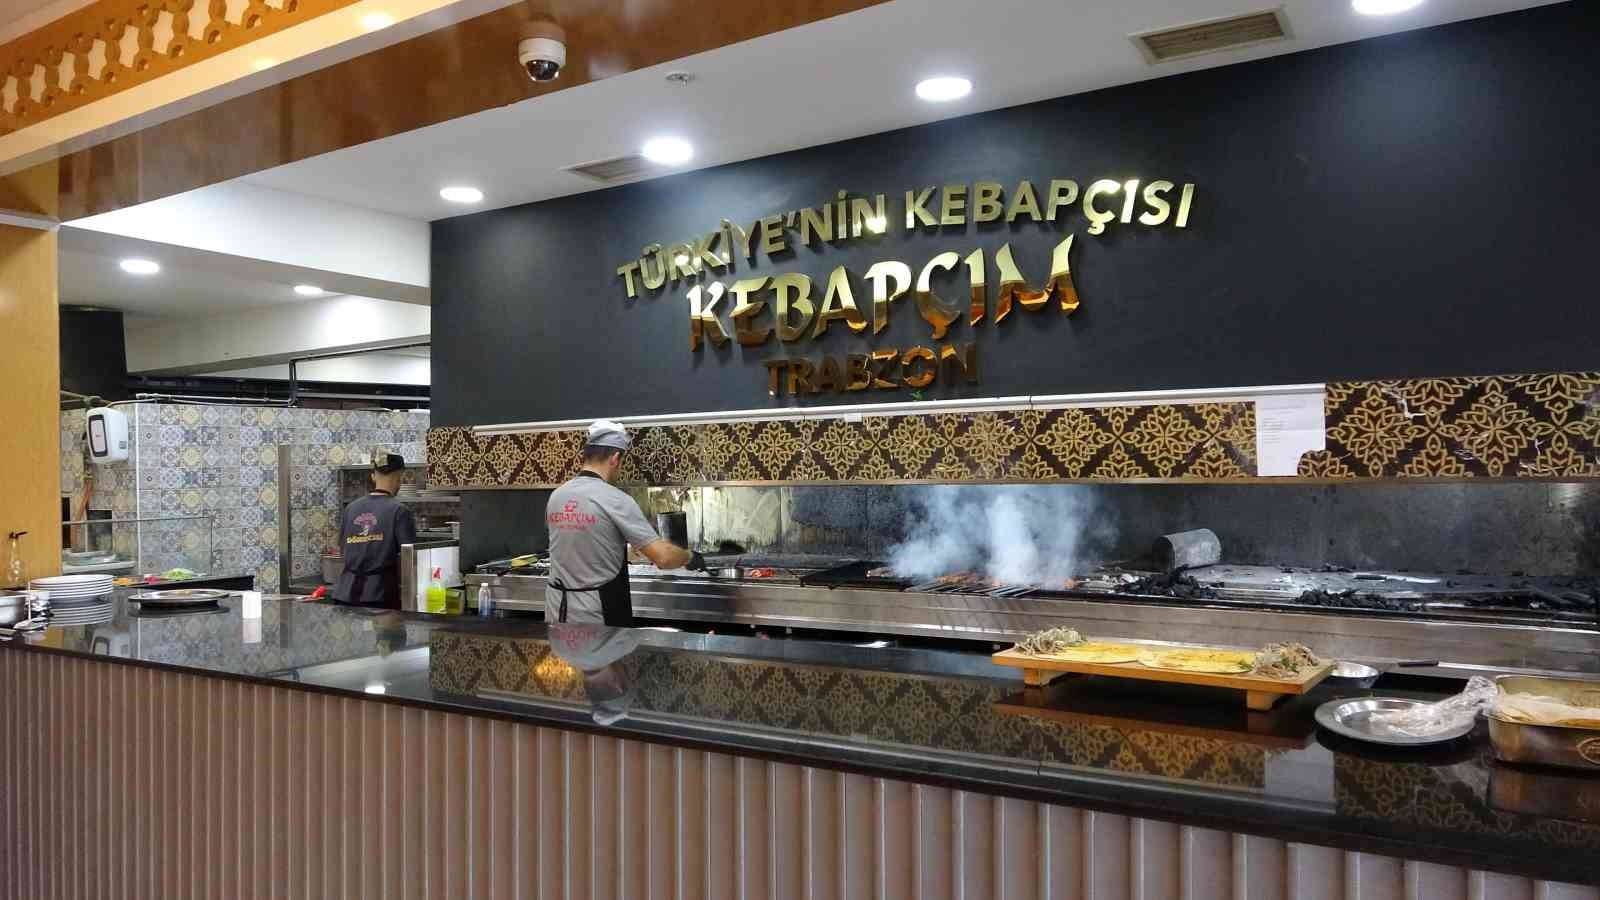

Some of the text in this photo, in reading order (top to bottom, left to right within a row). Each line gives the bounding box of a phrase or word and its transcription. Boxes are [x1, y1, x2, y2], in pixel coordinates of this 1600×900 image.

[905, 179, 1195, 235] KEBAPÇISI
[686, 233, 1080, 352] KEBAPÇIM
[764, 343, 978, 396] TRABZON
